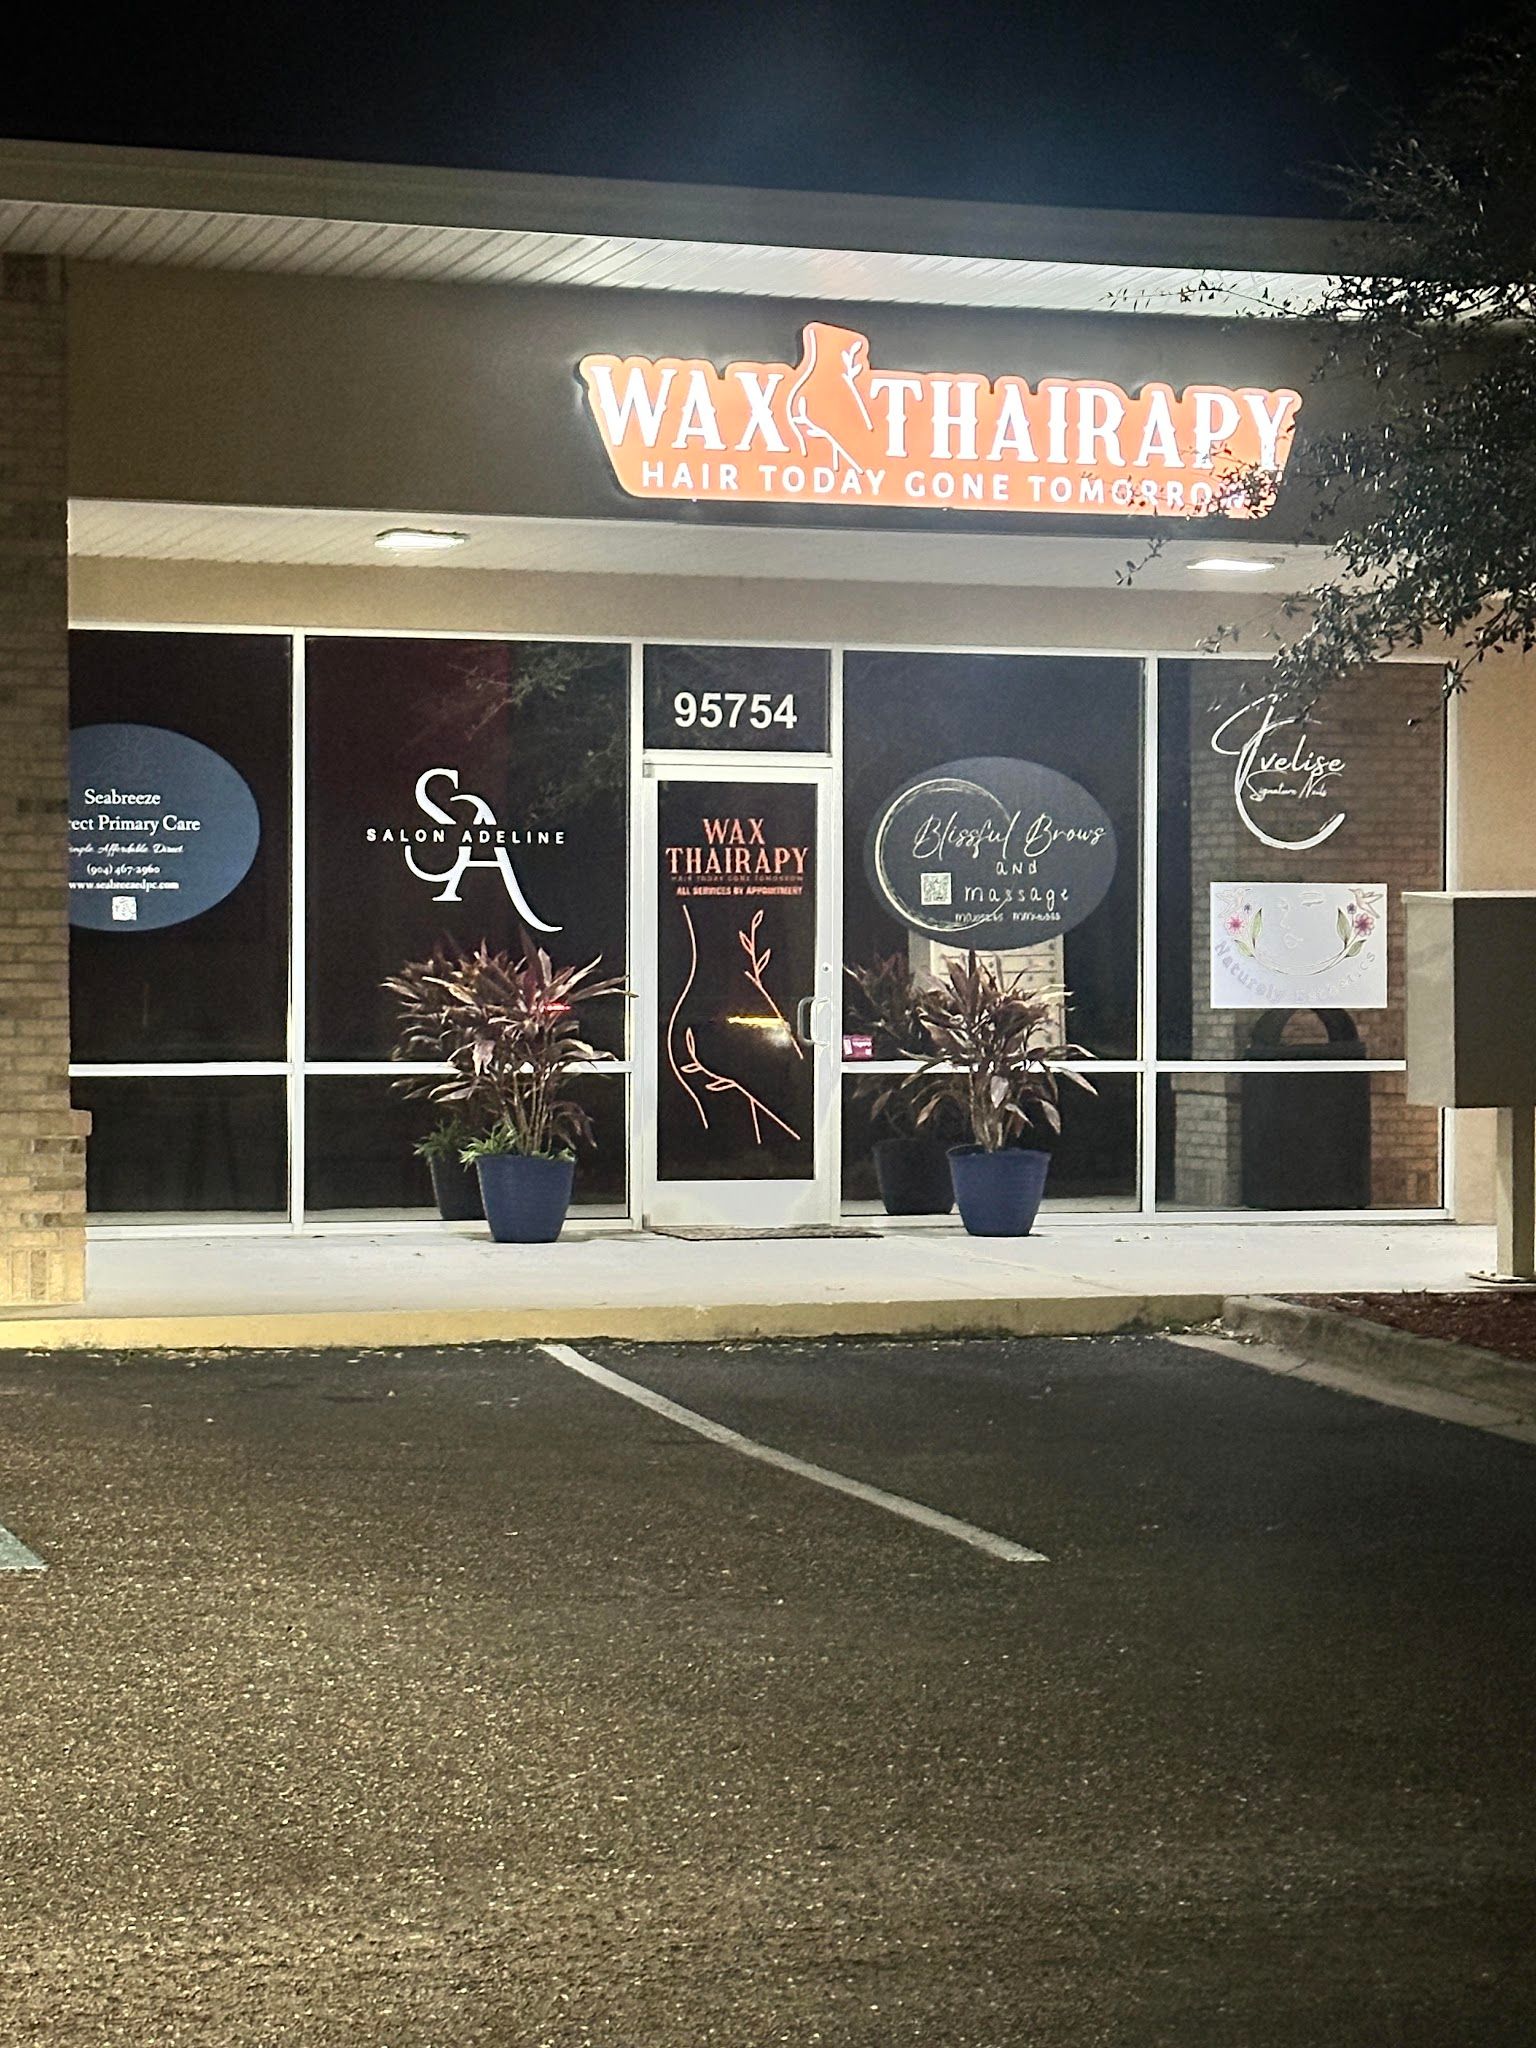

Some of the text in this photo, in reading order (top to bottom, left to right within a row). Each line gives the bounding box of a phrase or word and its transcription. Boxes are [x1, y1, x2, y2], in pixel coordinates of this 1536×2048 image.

[590, 365, 1294, 470] WAX THAIRAPY
[641, 459, 1250, 507] HAIR TODAY GONE TOMORRO
[674, 691, 797, 729] 95754
[84, 788, 161, 805] Seabreeze
[98, 815, 159, 836] Primary
[162, 815, 200, 831] Care
[366, 828, 565, 845] SALON ADELINE
[702, 817, 766, 845] WAX
[912, 811, 1106, 861] Blissful Brows
[87, 863, 113, 876] (904)
[665, 847, 808, 874] THAIRAPY
[676, 886, 803, 896] ALL SERVICES BY APPOINTMENT
